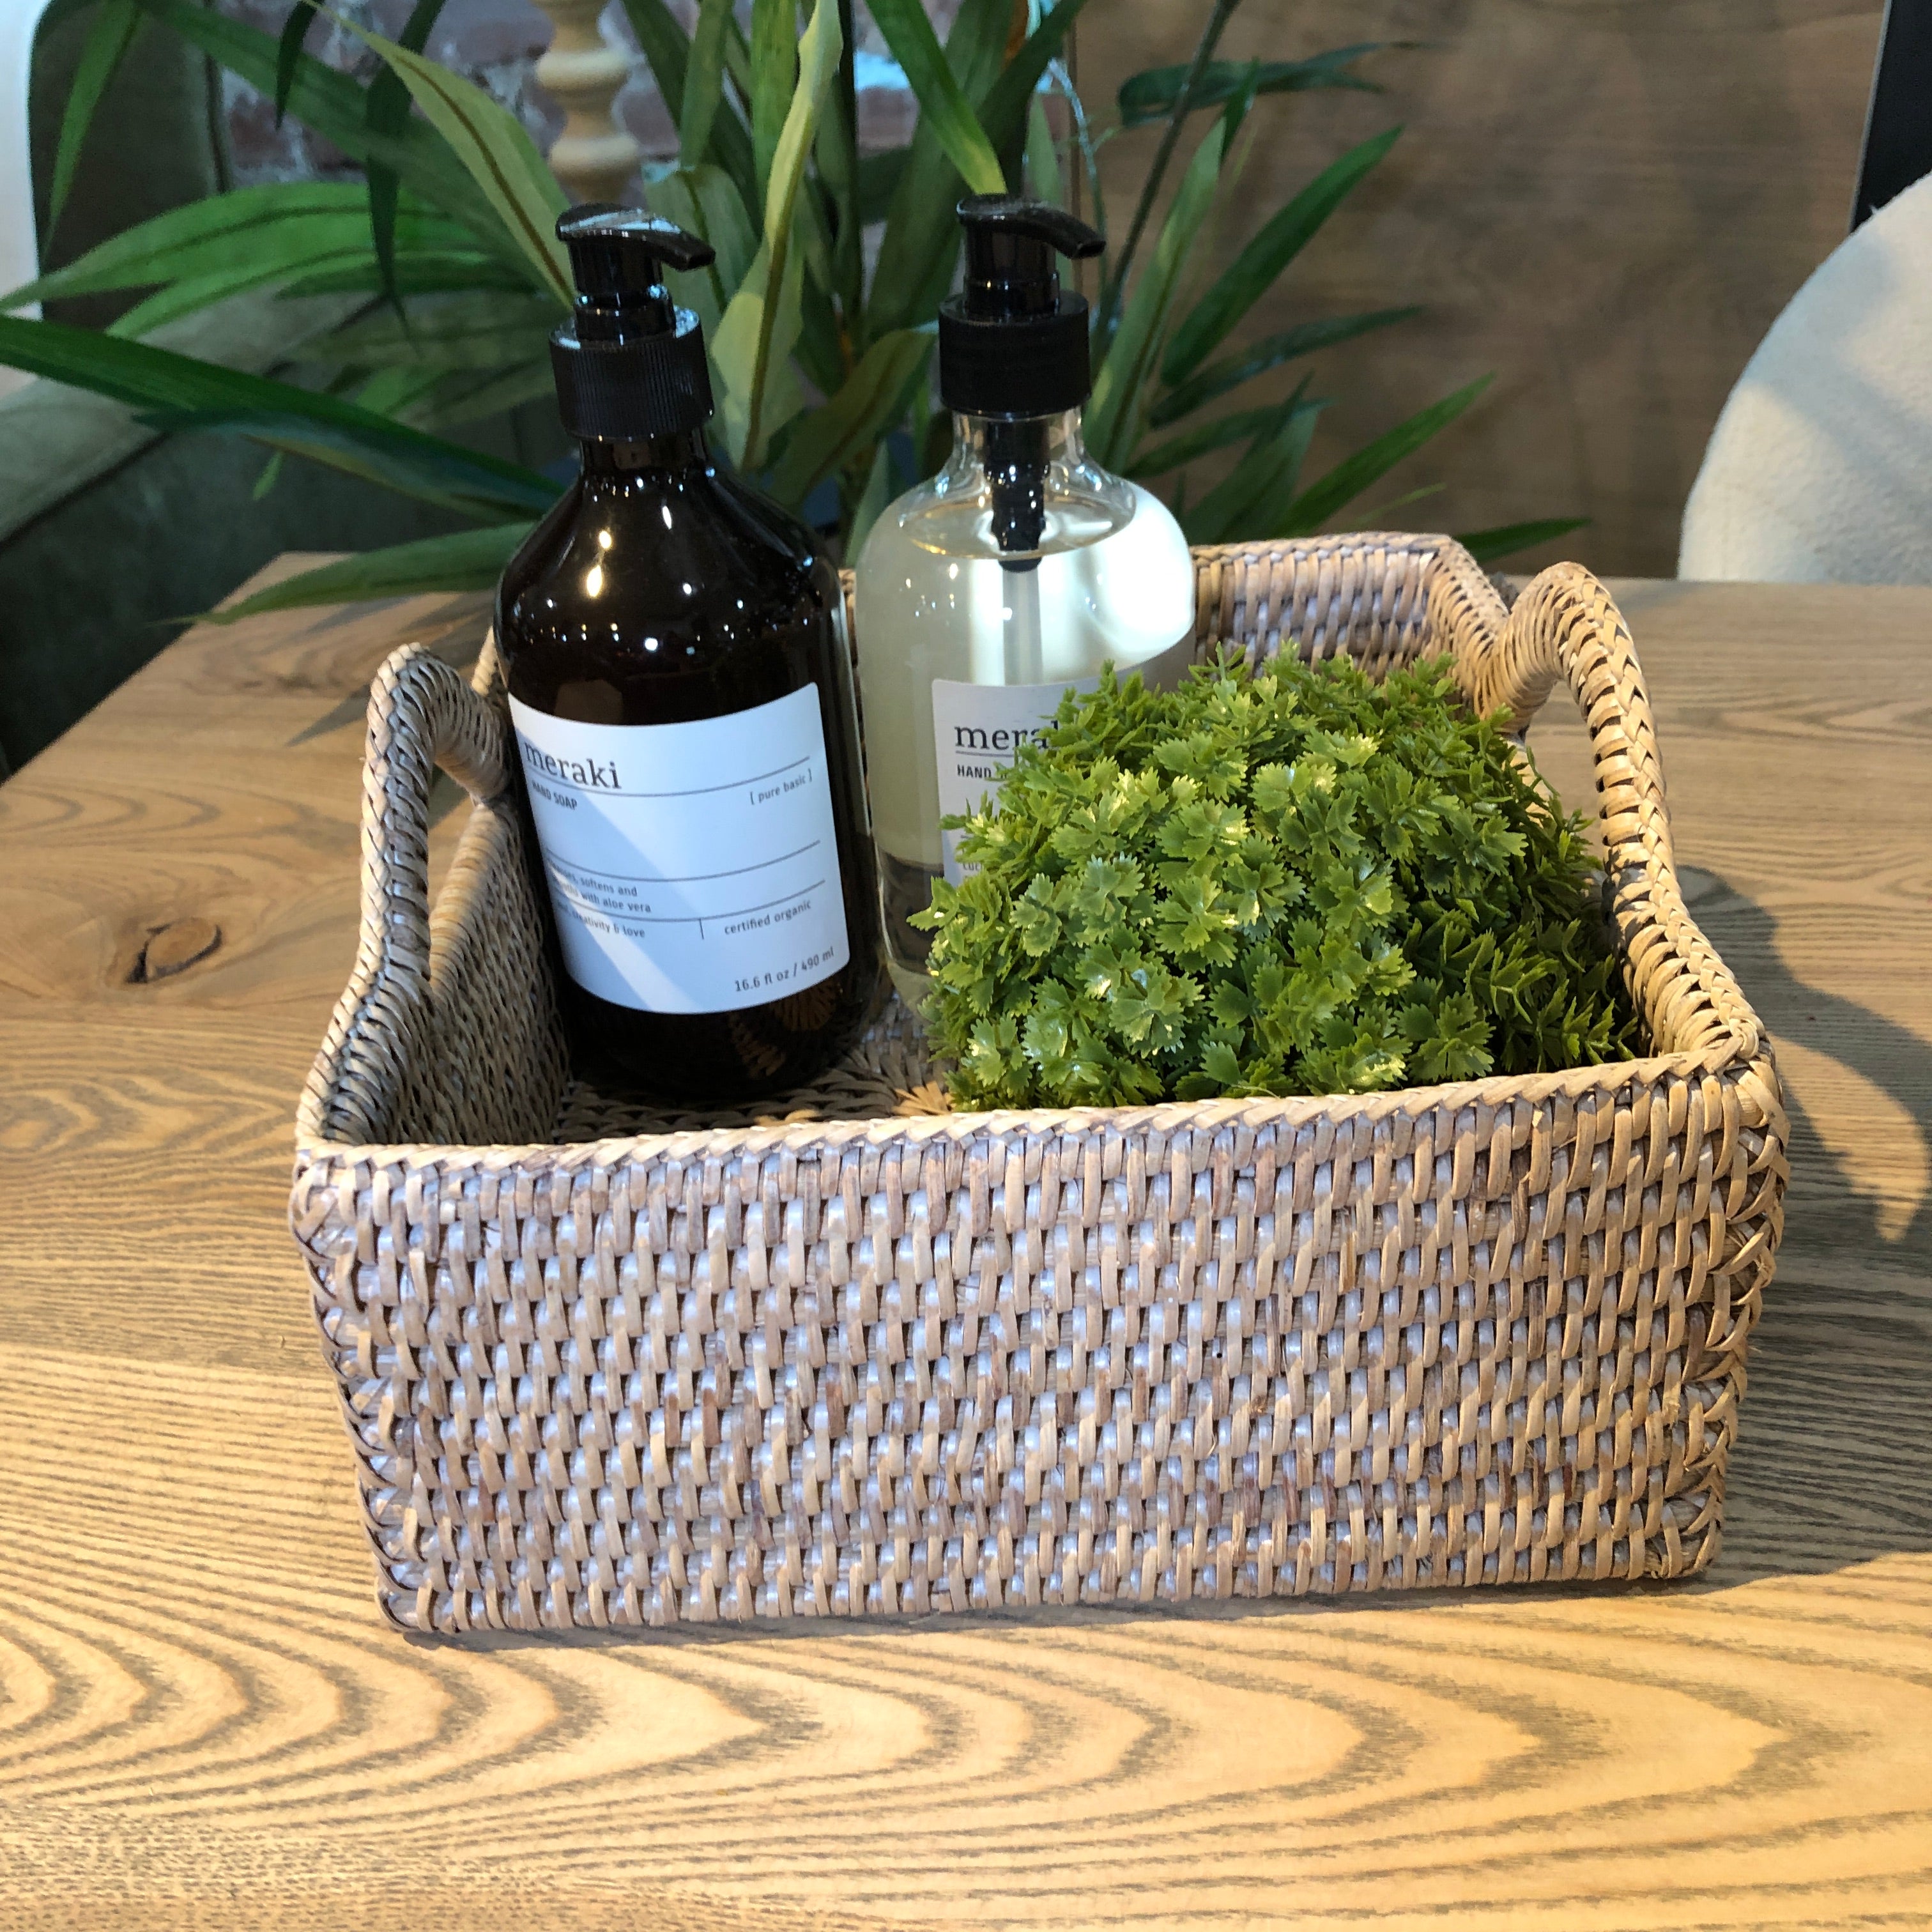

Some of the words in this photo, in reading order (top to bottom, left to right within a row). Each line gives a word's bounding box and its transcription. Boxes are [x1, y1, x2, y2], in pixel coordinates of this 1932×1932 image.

[954, 719, 1059, 750] mera
[524, 742, 622, 788] meraki
[957, 764, 992, 779] HAND
[532, 779, 552, 801] HAND
[553, 791, 578, 811] SOAP
[758, 786, 781, 804] pure
[783, 774, 806, 793] basic
[603, 898, 624, 910] aloe
[627, 903, 651, 913] vera
[618, 886, 638, 896] and
[623, 924, 645, 938] love
[724, 914, 770, 935] certified
[774, 900, 811, 921] organic
[735, 976, 760, 992] 16.6
[764, 972, 772, 985] fl
[776, 969, 789, 982] oz
[801, 954, 820, 971] 490
[822, 946, 835, 962] ml
